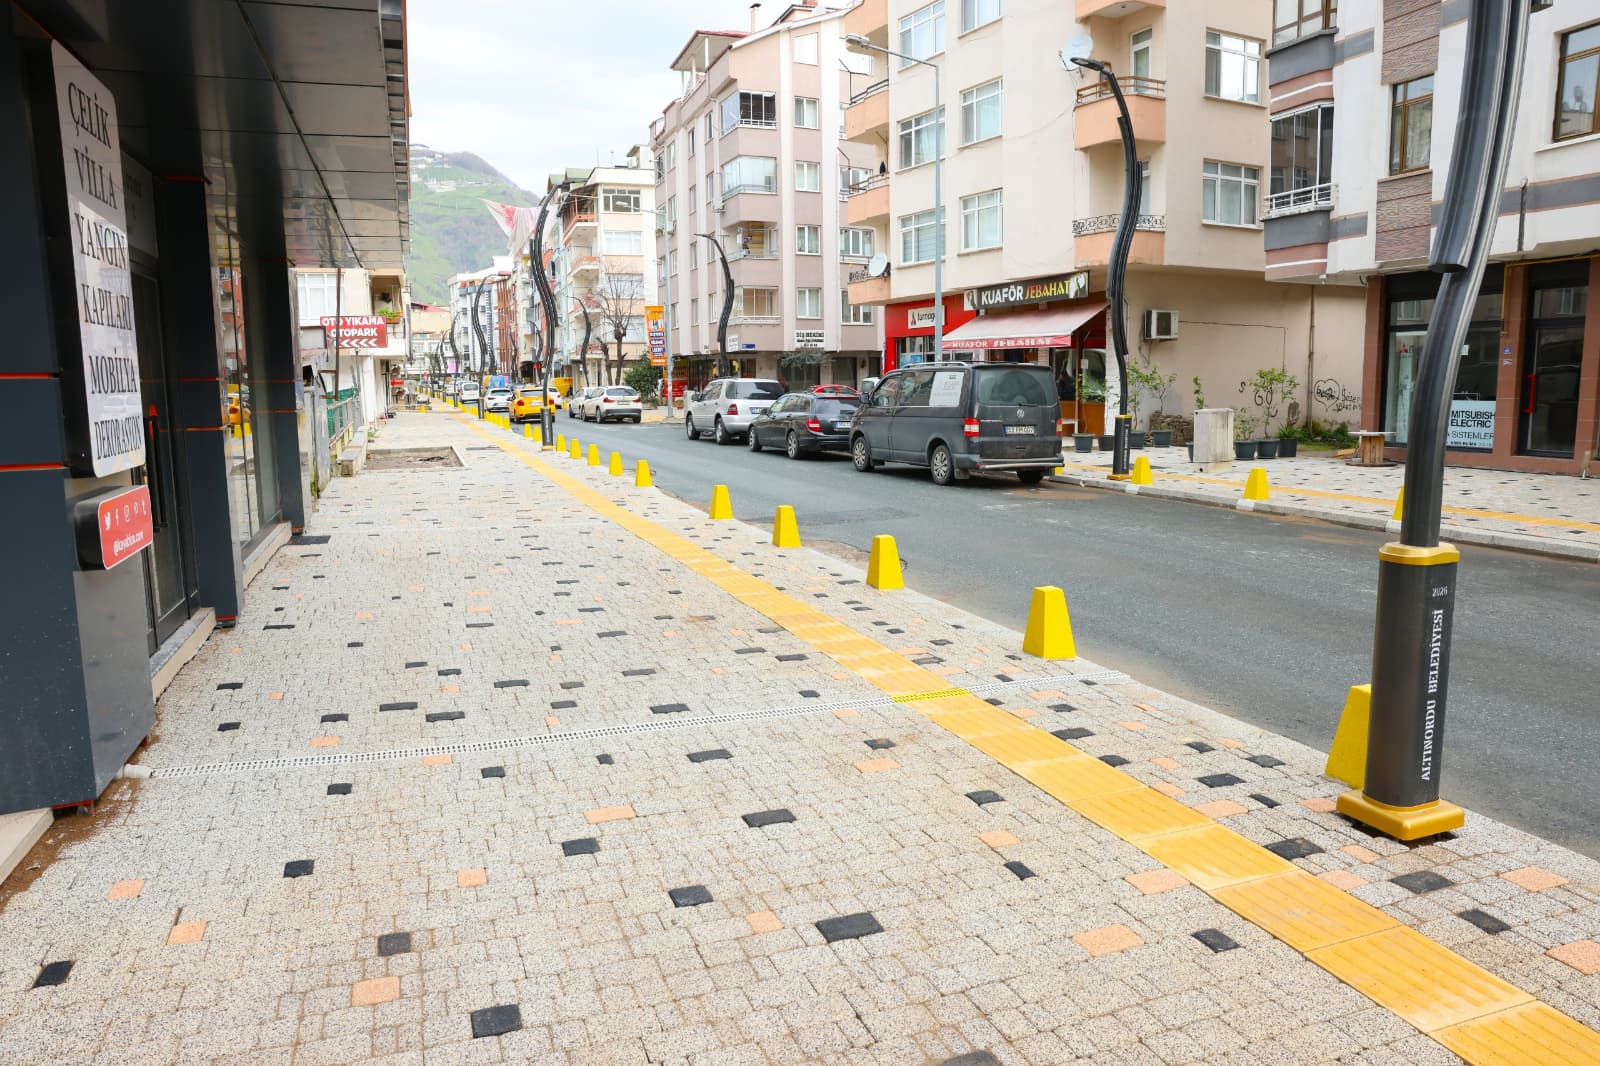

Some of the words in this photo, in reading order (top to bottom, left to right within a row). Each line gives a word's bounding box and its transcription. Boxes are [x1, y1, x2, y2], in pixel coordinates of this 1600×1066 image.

[68, 81, 111, 149] ÇELİK
[74, 145, 118, 210] VİLLA
[74, 212, 128, 270] YANGIN
[82, 283, 132, 330] KAPILARI
[981, 286, 1024, 305] KUAFÖR
[330, 328, 378, 337] OTOPARK
[345, 316, 384, 326] YIKAMA
[89, 347, 138, 394] MOBİLYA
[94, 416, 141, 460] DEKORASYON
[1450, 419, 1491, 429] ELECTRIC
[1451, 410, 1496, 420] MITSUBISH
[1428, 608, 1444, 694] BELEDİYESİ
[1421, 699, 1436, 781] ALTINORDU
